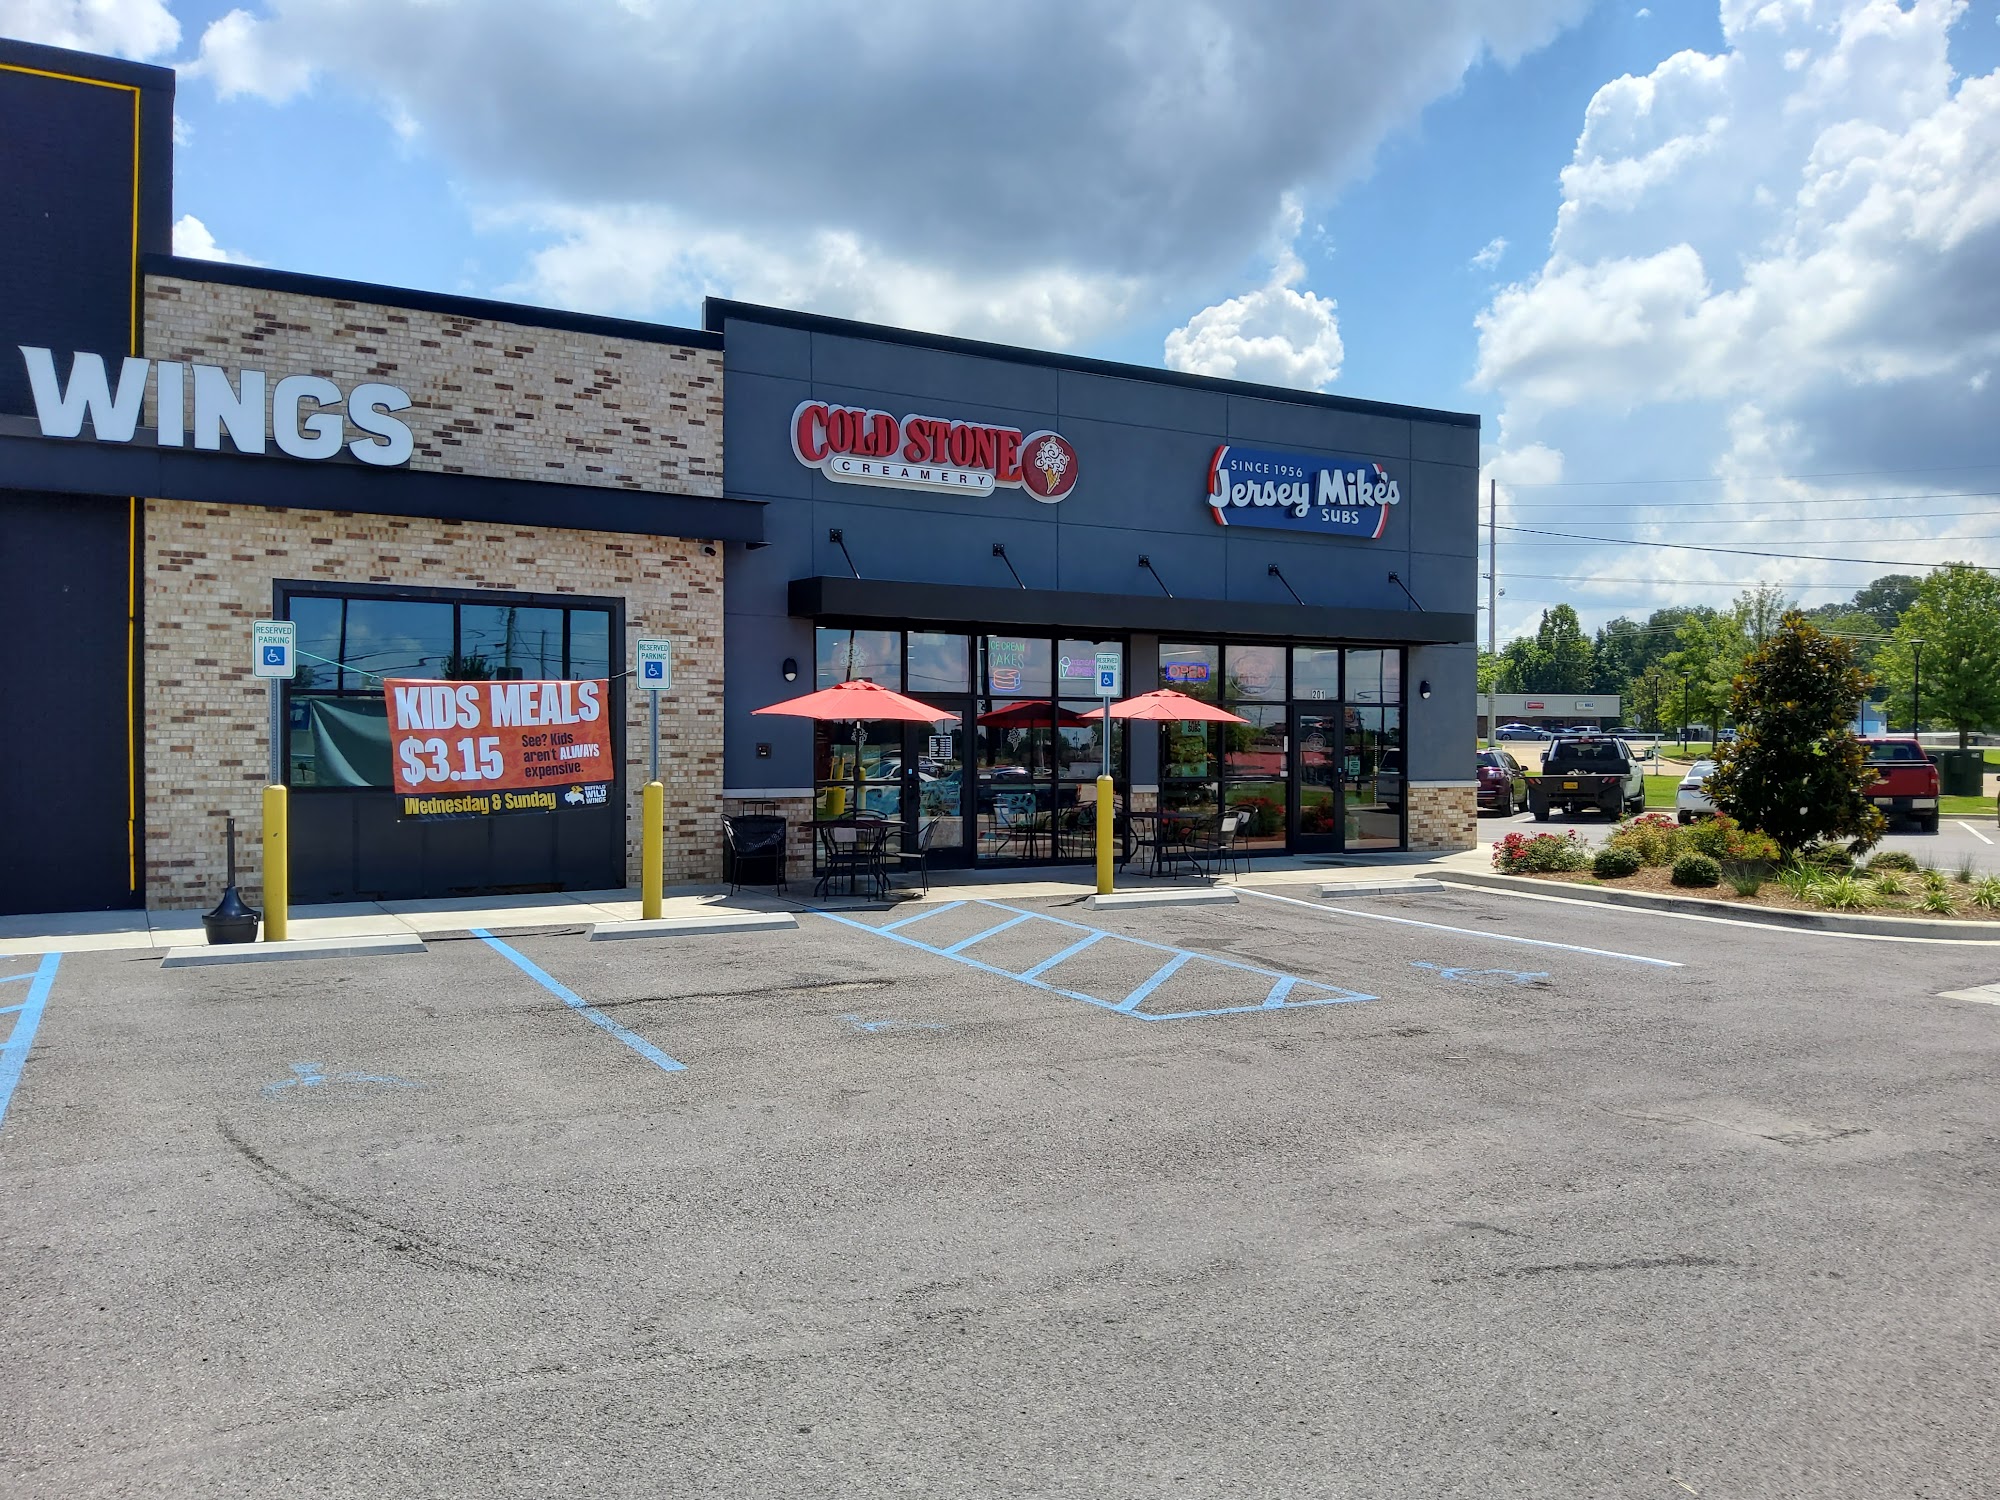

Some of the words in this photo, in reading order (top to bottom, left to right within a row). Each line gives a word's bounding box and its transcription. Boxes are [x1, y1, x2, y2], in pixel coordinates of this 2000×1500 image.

[17, 345, 415, 467] WINGS
[798, 404, 900, 462] COLD
[903, 418, 1023, 482] STONE
[841, 460, 986, 486] CREAMERY
[1230, 459, 1269, 474] SINCE
[1274, 464, 1303, 477] 1956
[1208, 468, 1310, 518] Jersey
[1317, 469, 1400, 507] Mike's
[1321, 508, 1359, 525] SUBS
[256, 626, 292, 634] RESERVED
[258, 636, 290, 644] PARKING
[989, 641, 1000, 650] ICE
[1001, 642, 1025, 652] CREAM
[641, 652, 666, 660] PARKING
[989, 653, 1025, 669] CAKES
[1168, 664, 1207, 678] OPEN
[1312, 690, 1325, 699] 201
[394, 685, 481, 731] KIDS
[490, 681, 600, 728] MEALS
[1187, 725, 1202, 733] SUBS
[522, 733, 548, 748] See?
[550, 732, 573, 746] Kids
[399, 735, 505, 787] $3.15
[523, 748, 557, 763] aren't
[559, 743, 600, 761] ALWAYS
[525, 762, 584, 779] expensive.
[585, 789, 607, 798] WILD
[586, 796, 607, 804] WINGS
[404, 795, 490, 816] Wednesday
[492, 793, 502, 811] &
[505, 791, 557, 811] Sunday
